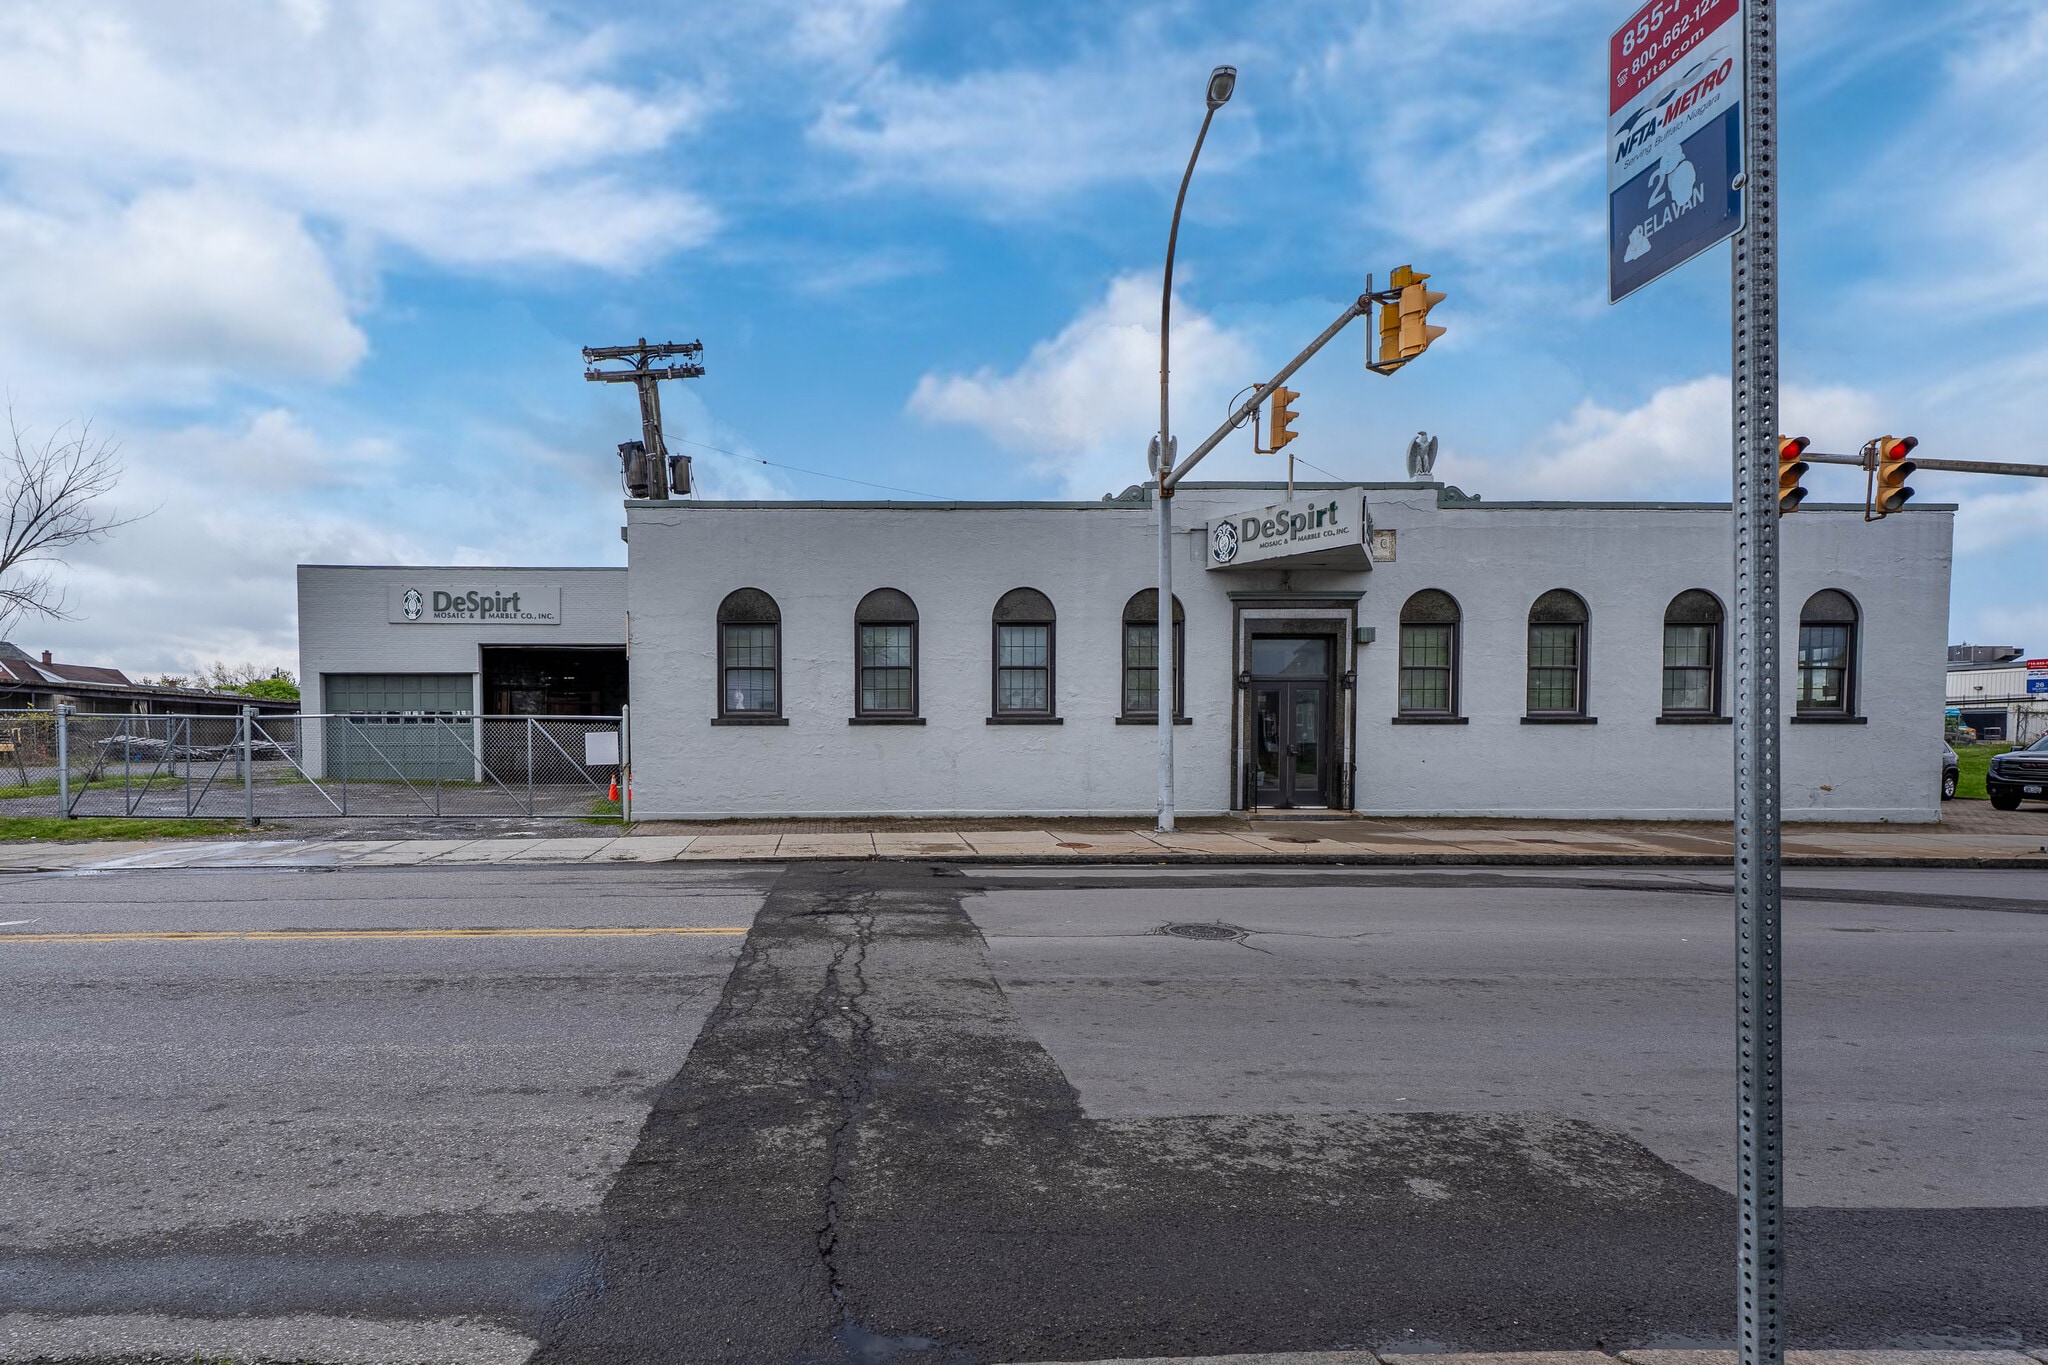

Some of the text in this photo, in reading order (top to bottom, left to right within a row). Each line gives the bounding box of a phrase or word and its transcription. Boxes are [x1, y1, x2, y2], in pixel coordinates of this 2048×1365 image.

[1638, 27, 1705, 88] nfta.com
[1615, 57, 1733, 164] NFTA-METRO
[1623, 93, 1721, 170] Serving Buffalo Niagara
[1241, 500, 1339, 543] DeSpirt
[1259, 538, 1283, 549] MOSAIC
[1297, 532, 1321, 542] MARBLE
[1336, 526, 1350, 535] INC.
[433, 590, 521, 620] DeSpirt
[488, 612, 518, 620] MARBLE
[538, 612, 555, 620] INC.
